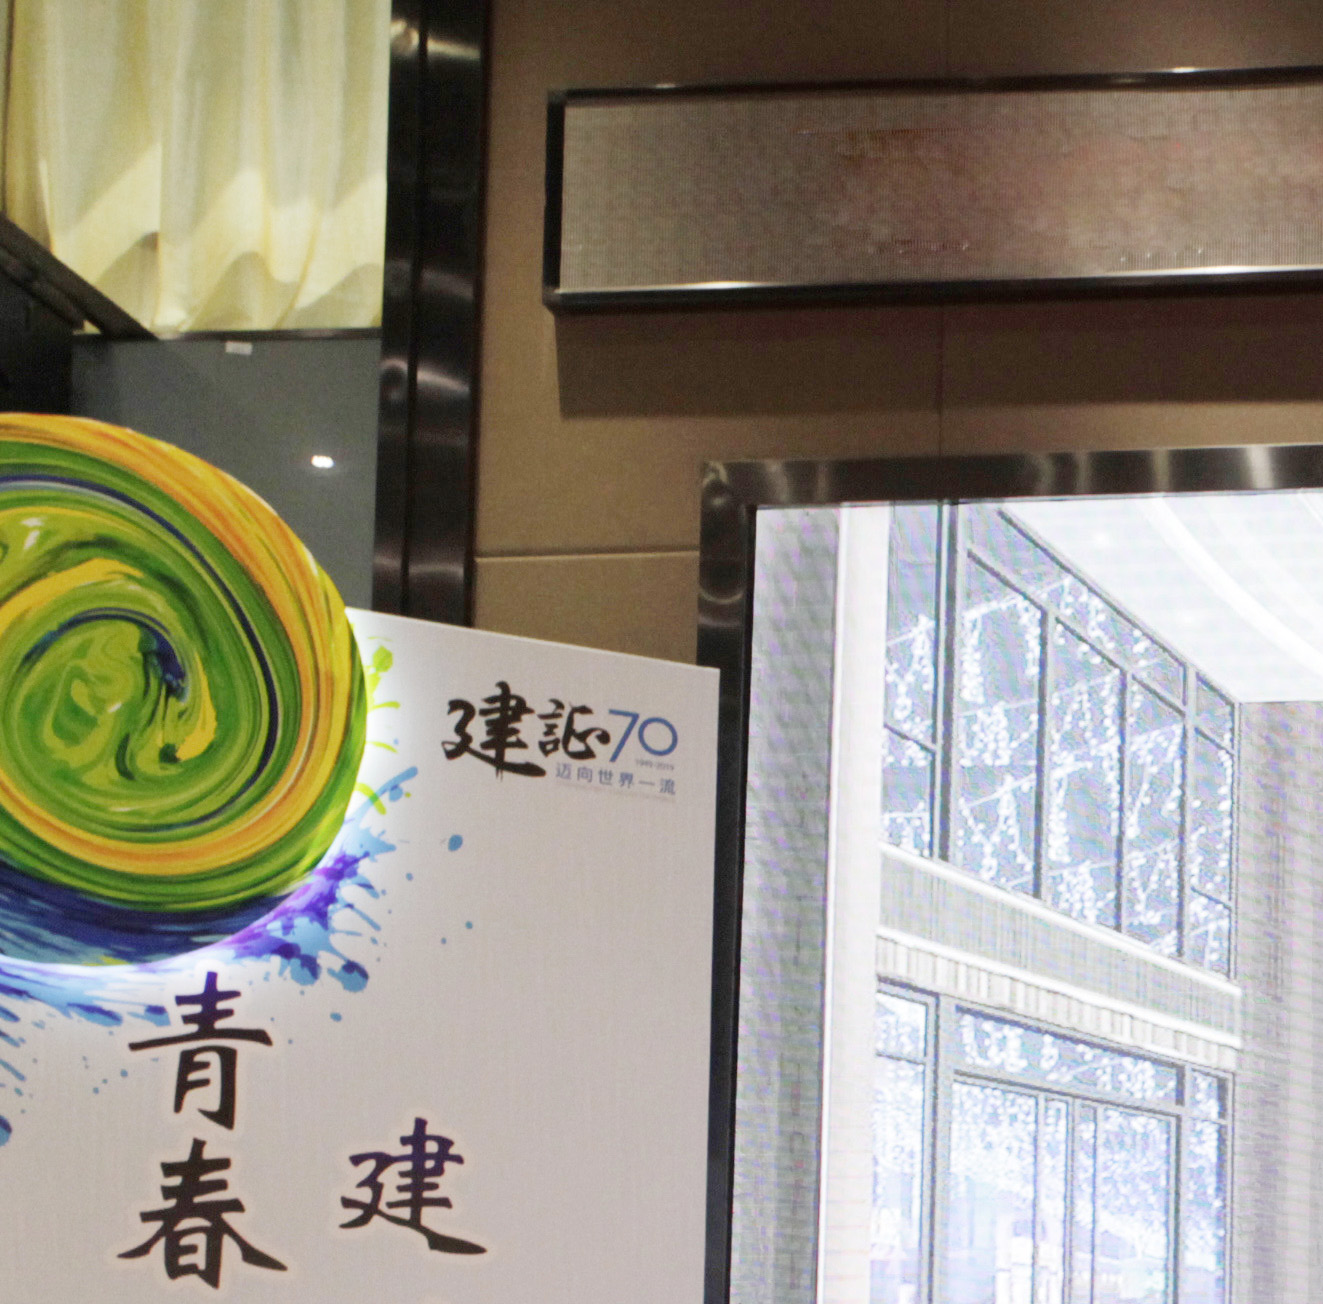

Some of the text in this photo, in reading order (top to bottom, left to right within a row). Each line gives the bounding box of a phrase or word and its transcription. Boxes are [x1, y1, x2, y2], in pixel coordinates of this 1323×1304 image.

[608, 709, 678, 763] 70
[555, 761, 677, 796] 迈向世界一流
